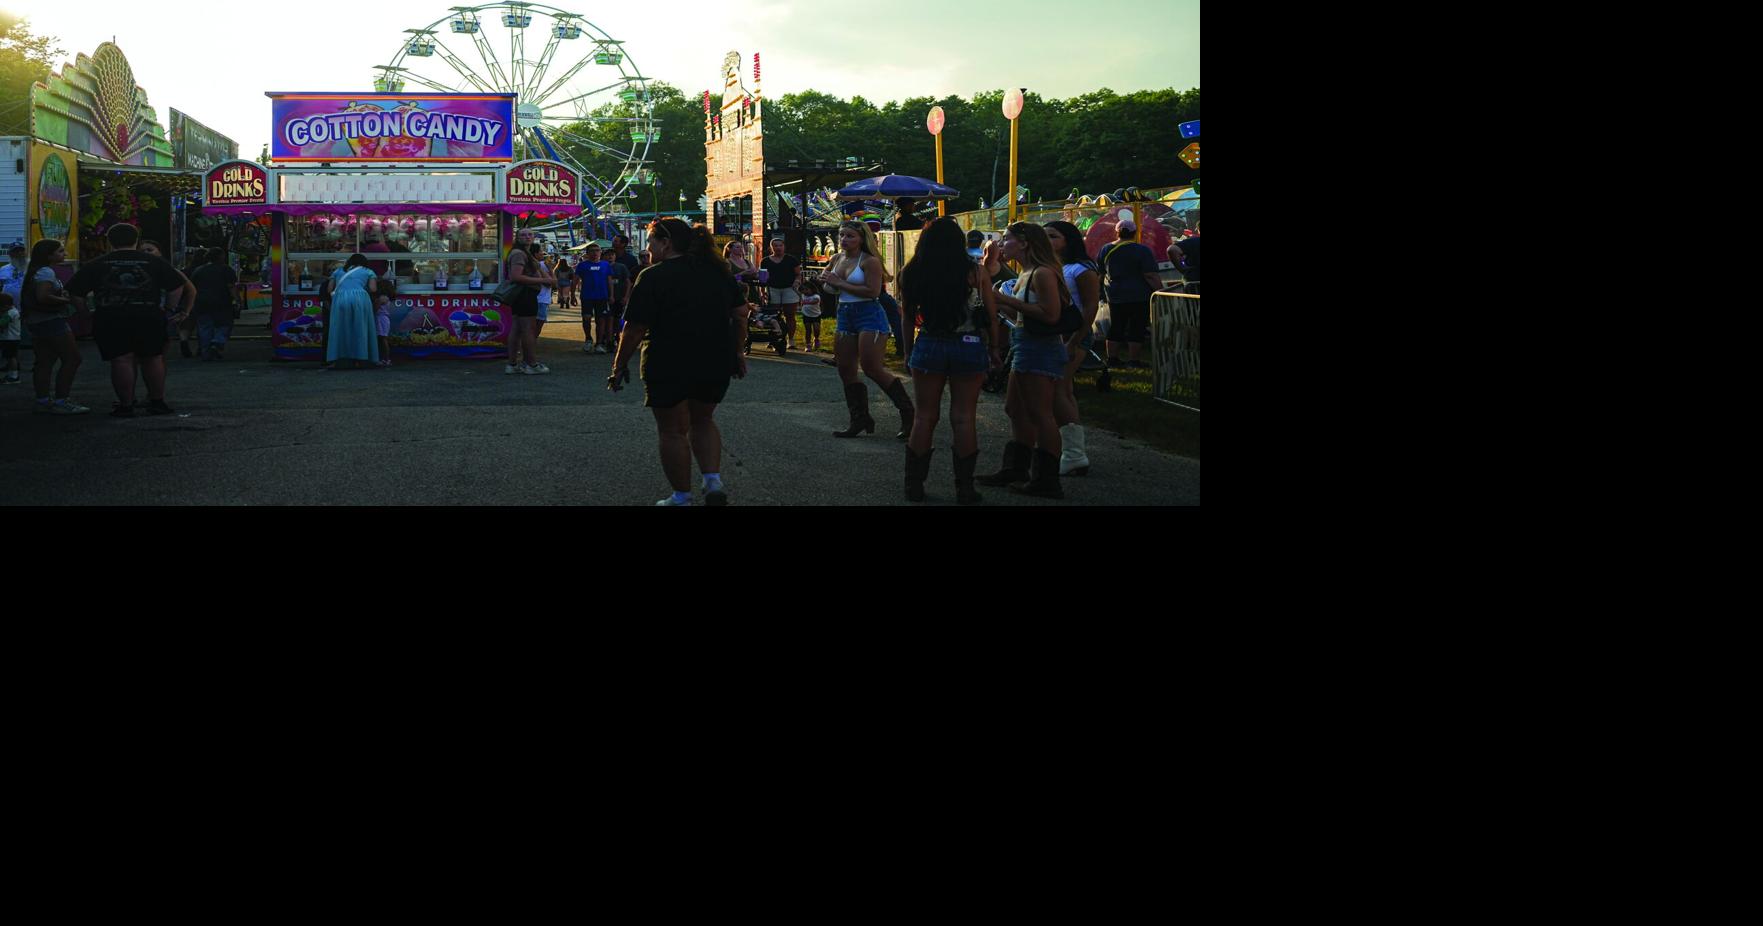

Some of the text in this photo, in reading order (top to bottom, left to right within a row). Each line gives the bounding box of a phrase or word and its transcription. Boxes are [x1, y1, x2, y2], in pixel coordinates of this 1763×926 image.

[286, 111, 502, 146] COTTON CANDY
[223, 167, 253, 182] COLD
[523, 167, 559, 181] COLD
[212, 178, 264, 198] DRINKS
[510, 177, 571, 198] DRINKS
[282, 299, 314, 308] SNO
[394, 299, 501, 308] COLD DRINKS
